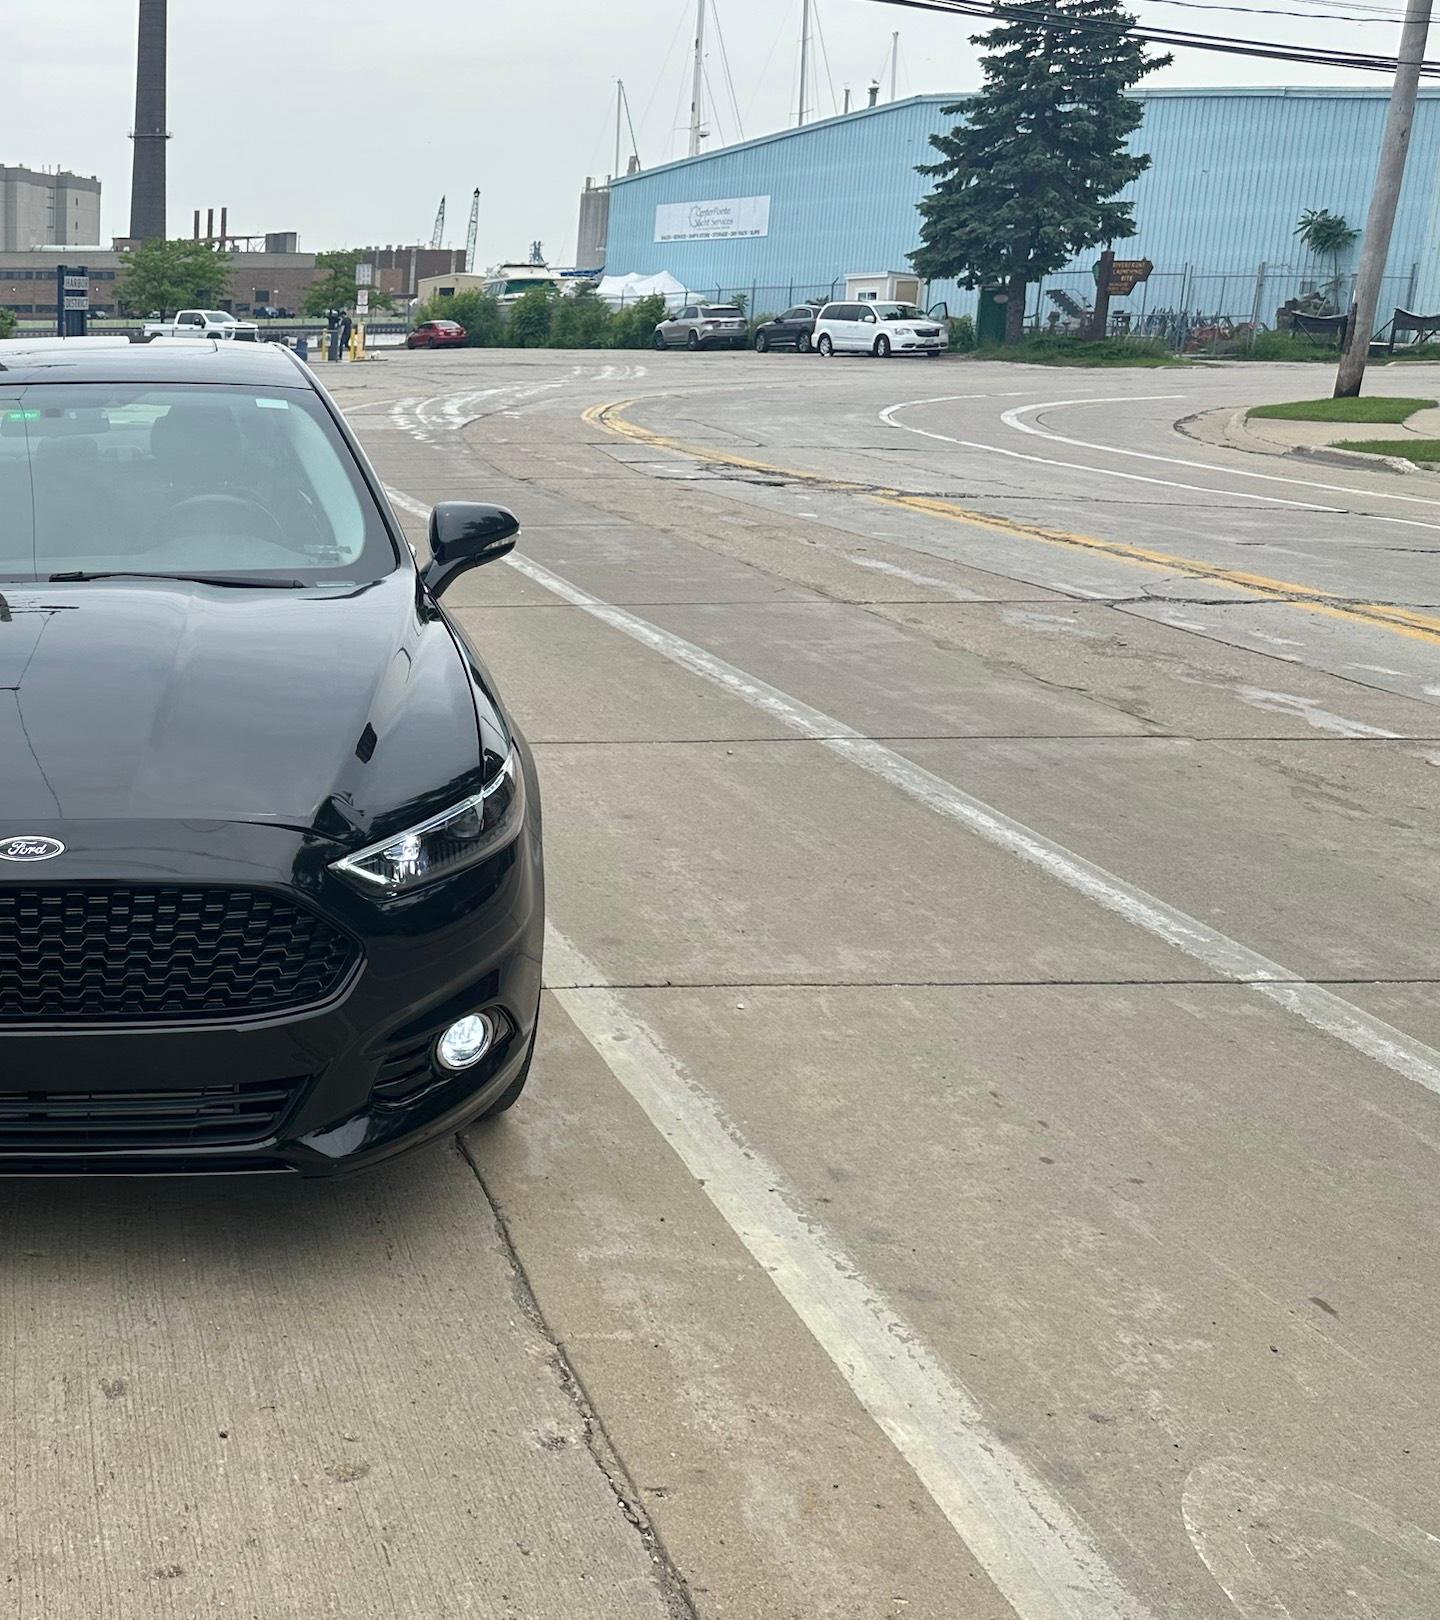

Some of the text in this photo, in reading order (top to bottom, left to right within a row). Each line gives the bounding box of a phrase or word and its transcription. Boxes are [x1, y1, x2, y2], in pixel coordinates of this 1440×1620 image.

[711, 217, 734, 226] Services
[66, 278, 88, 288] HARBOR
[66, 299, 88, 308] DISTRICT
[7, 841, 48, 855] Ford
